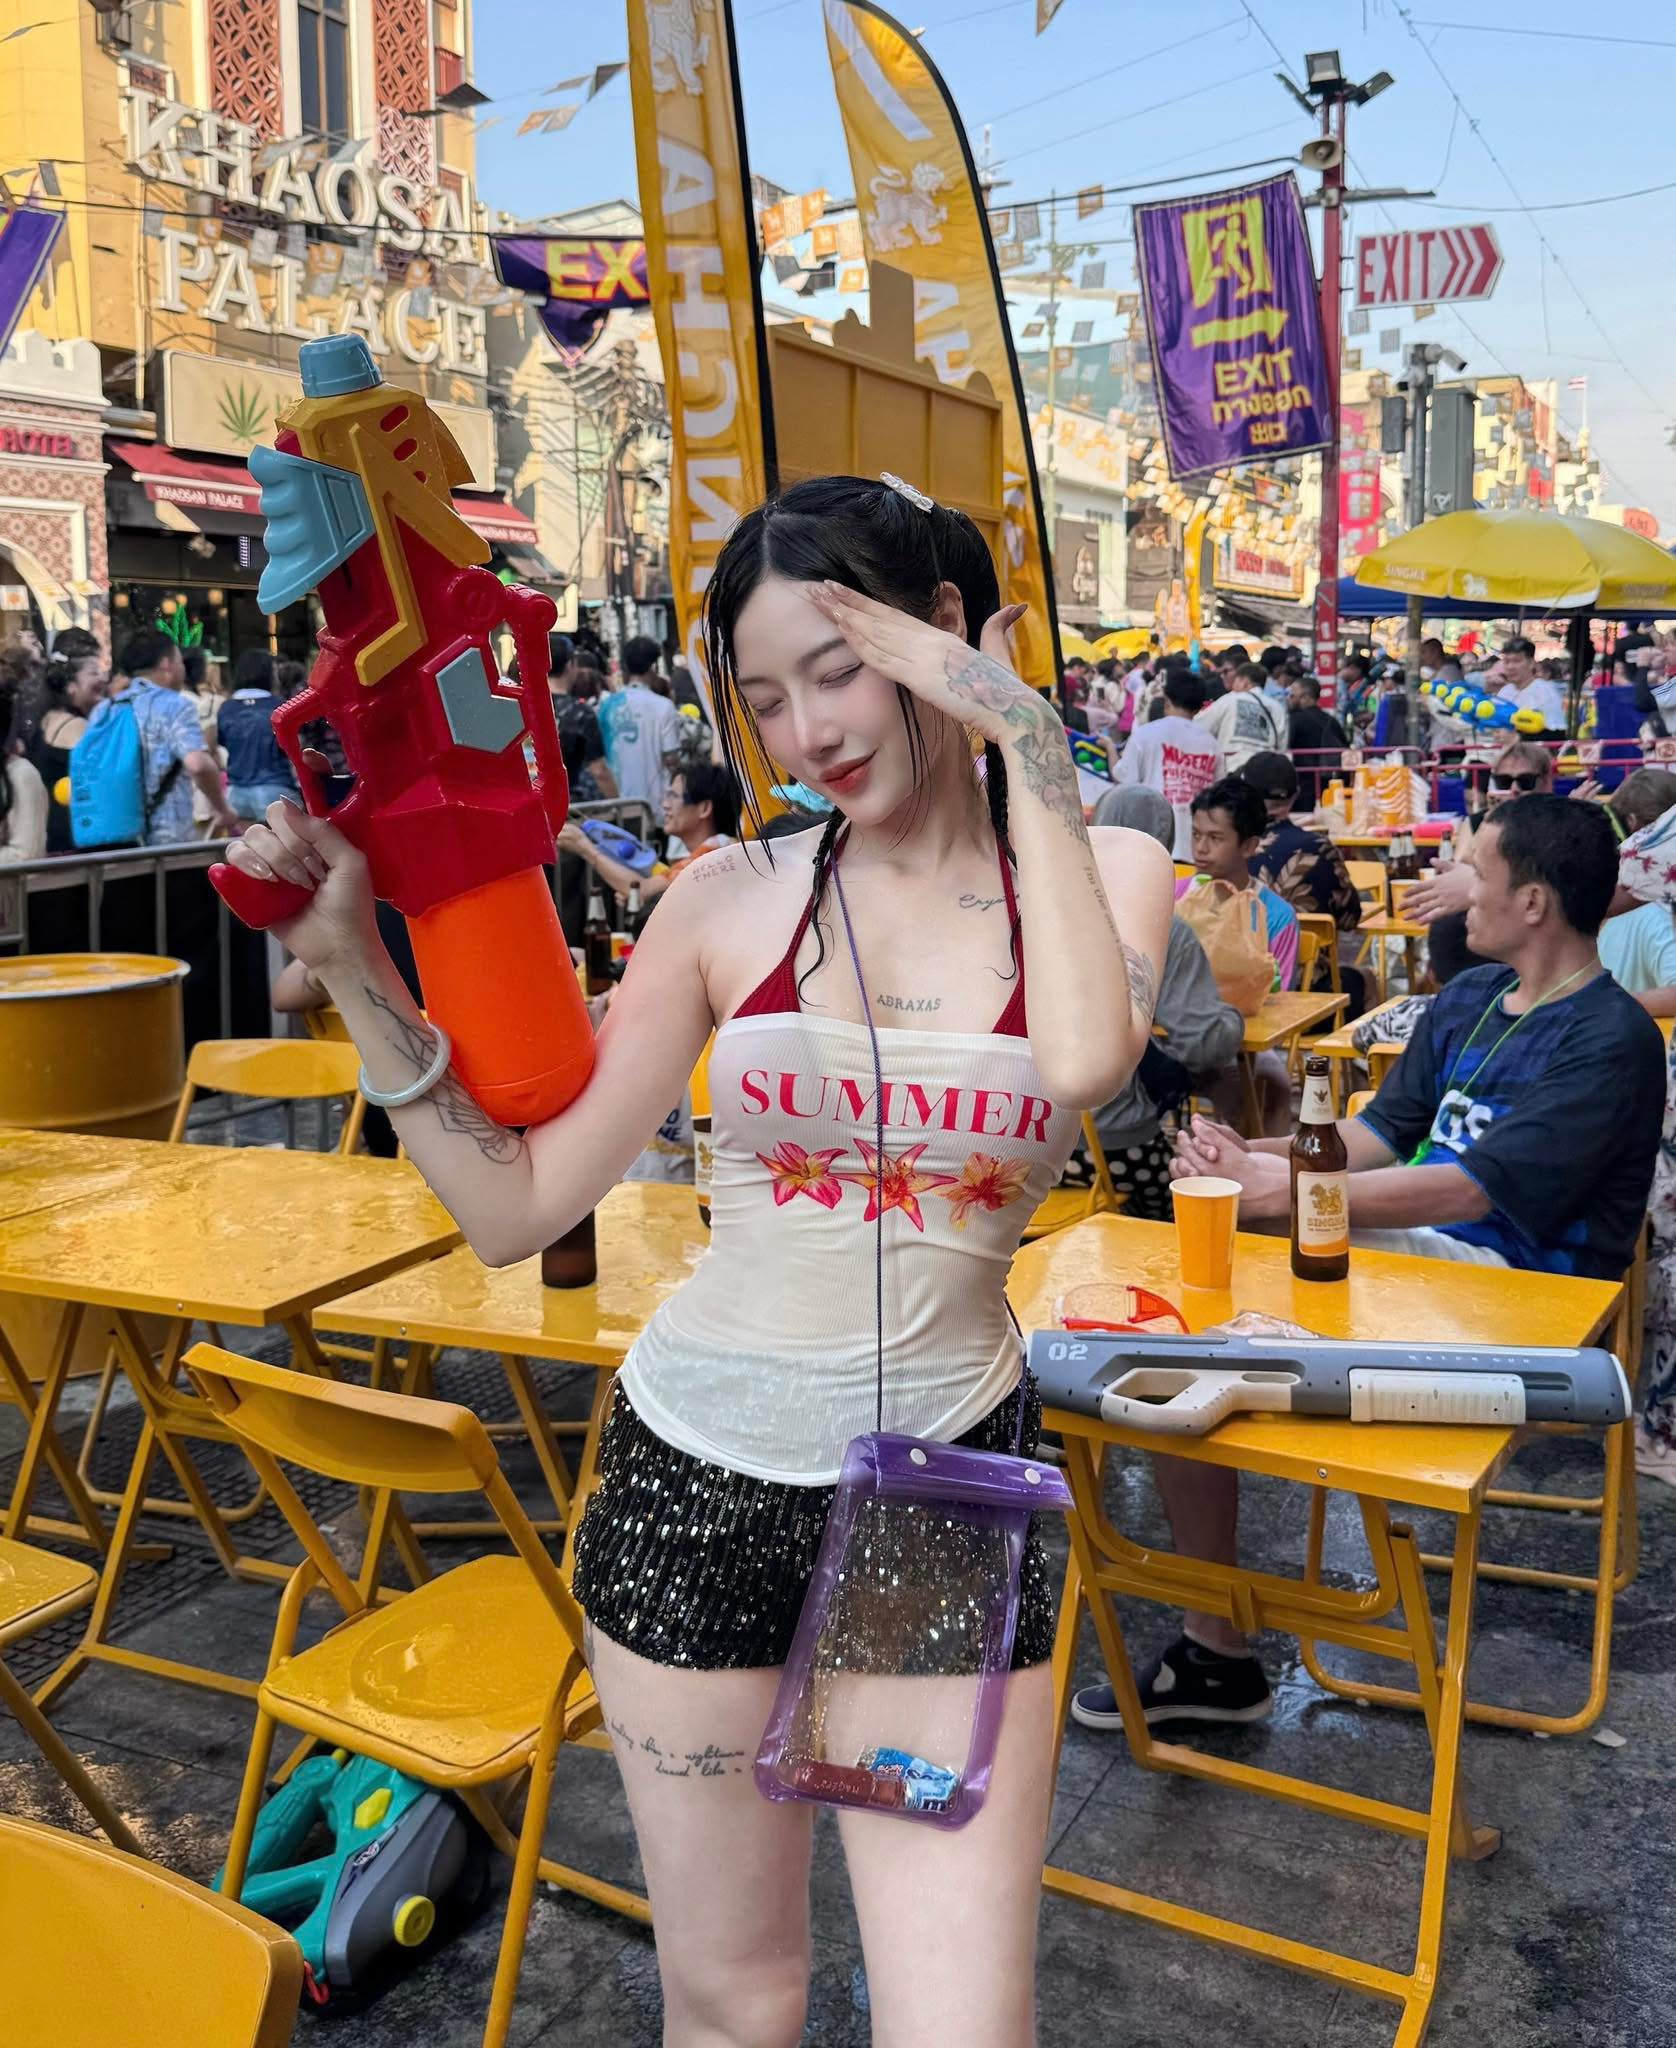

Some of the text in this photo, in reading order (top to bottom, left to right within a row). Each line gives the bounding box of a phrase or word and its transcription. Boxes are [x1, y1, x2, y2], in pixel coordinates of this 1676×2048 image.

[1359, 231, 1436, 305] EXIT
[156, 226, 488, 376] PALACE
[1214, 347, 1294, 396] EXIT
[1212, 385, 1312, 424] ทางออก
[876, 994, 941, 1012] ABRAXAS
[741, 1068, 1053, 1143] SUMMER
[1048, 1342, 1089, 1361] 02
